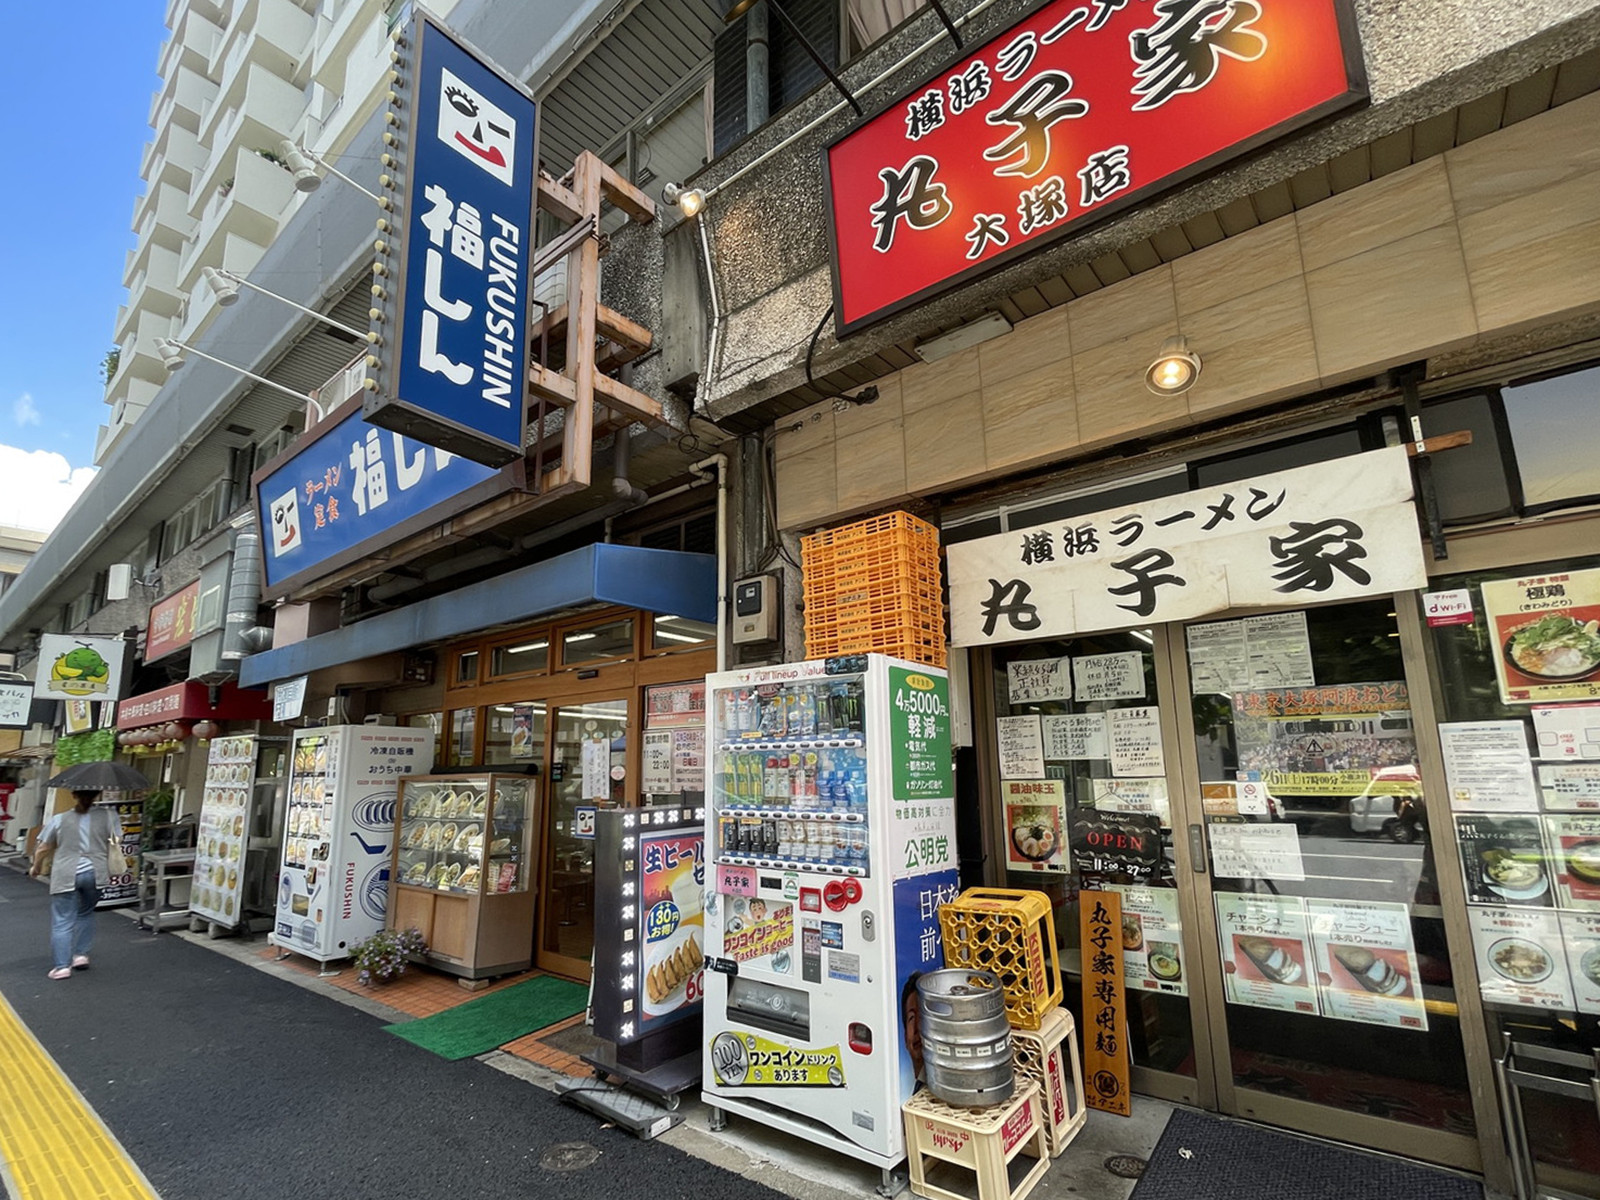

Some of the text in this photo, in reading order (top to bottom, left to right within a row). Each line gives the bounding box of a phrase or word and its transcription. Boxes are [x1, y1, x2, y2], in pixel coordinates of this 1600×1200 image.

[869, 0, 1268, 253] 丸子家
[965, 144, 1130, 260] 大塚店
[418, 183, 485, 387] 福しん
[482, 212, 520, 410] FUKUSHIN
[305, 461, 342, 505] ラーメン
[314, 495, 340, 530] 定食
[1021, 487, 1287, 566] 横浜ラーメン
[980, 518, 1373, 637] 丸子家
[1526, 584, 1565, 600] 極鶏
[908, 714, 937, 739] 軽減
[369, 746, 414, 756] 冷凍自販機
[368, 765, 413, 775] おうち中華
[904, 834, 949, 869] 公明党
[1086, 831, 1144, 851] OPEN
[342, 862, 356, 920] FUKUSHIN
[649, 909, 680, 927] 130円
[724, 918, 794, 954] ワンコインコーヒー
[733, 947, 759, 962] Taste
[761, 944, 769, 953] is
[1029, 932, 1045, 996] KIRIN
[1089, 901, 1118, 1058] 丸子家専用麺
[715, 1038, 742, 1070] 100
[723, 1061, 745, 1080] YEN
[750, 1050, 837, 1067] ワンコインドリンク
[774, 1069, 808, 1082] あります
[932, 1133, 964, 1153] Asahi
